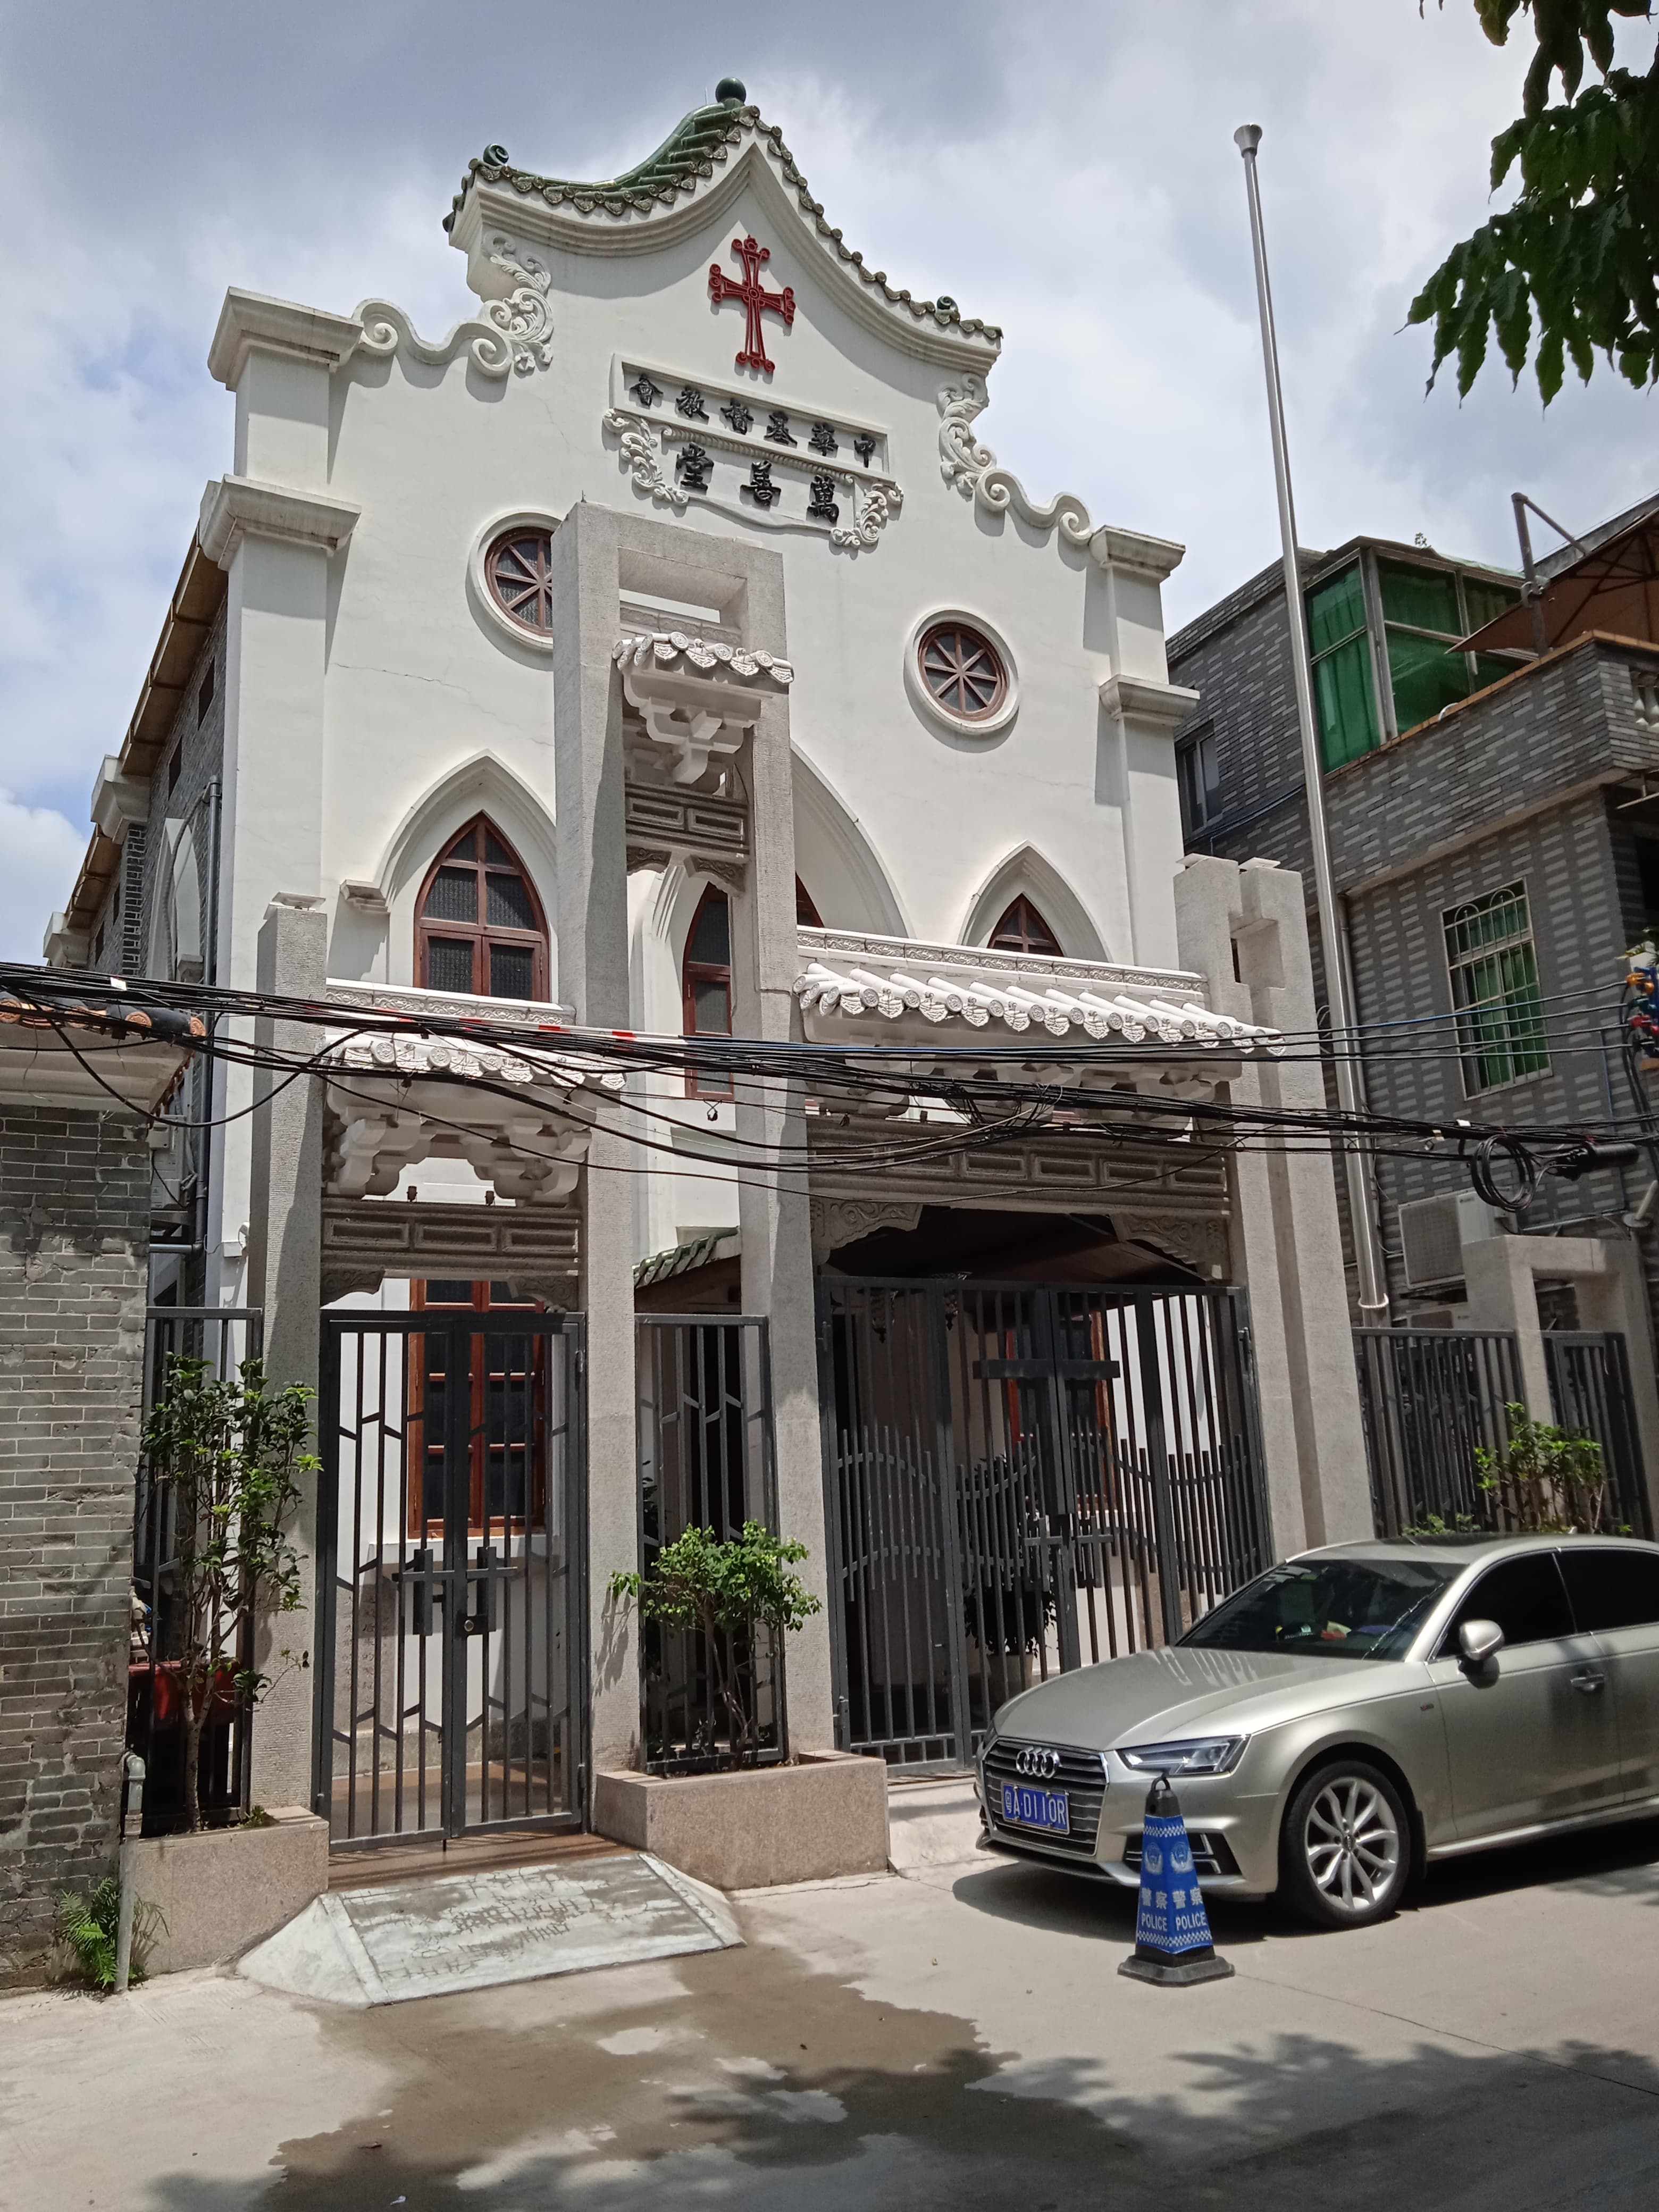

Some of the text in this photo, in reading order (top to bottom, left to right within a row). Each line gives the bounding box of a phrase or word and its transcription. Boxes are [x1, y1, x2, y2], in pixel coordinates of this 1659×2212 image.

[630, 373, 876, 468] 中華基督教會
[676, 441, 840, 523] 萬善堂
[1141, 1887, 1168, 1910] 警察
[1172, 1887, 1203, 1909] 警察
[1141, 1912, 1168, 1932] POLICE
[1175, 1911, 1207, 1931] POLICE
